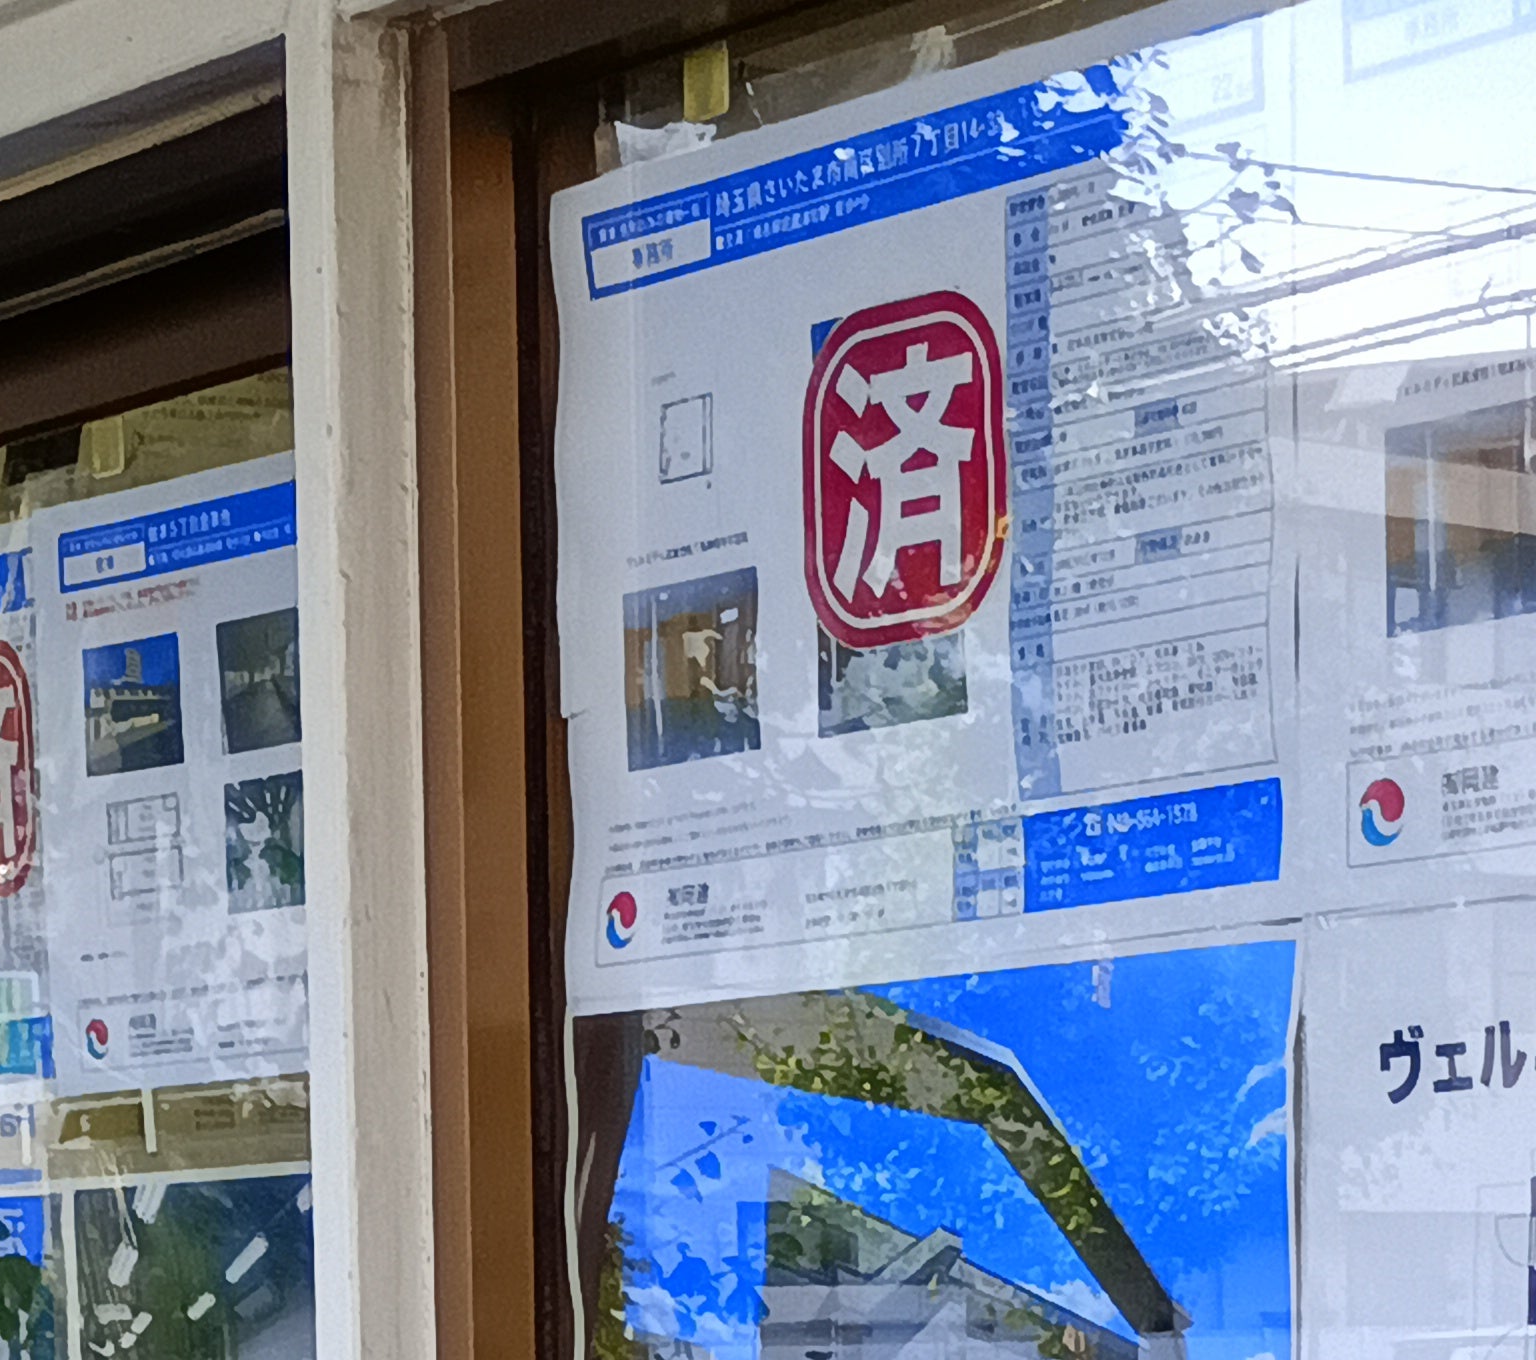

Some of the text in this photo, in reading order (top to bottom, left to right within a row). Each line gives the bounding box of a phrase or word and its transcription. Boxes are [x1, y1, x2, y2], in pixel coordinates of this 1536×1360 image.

[827, 343, 978, 603] 済
[1378, 1020, 1536, 1104] ヴェル
